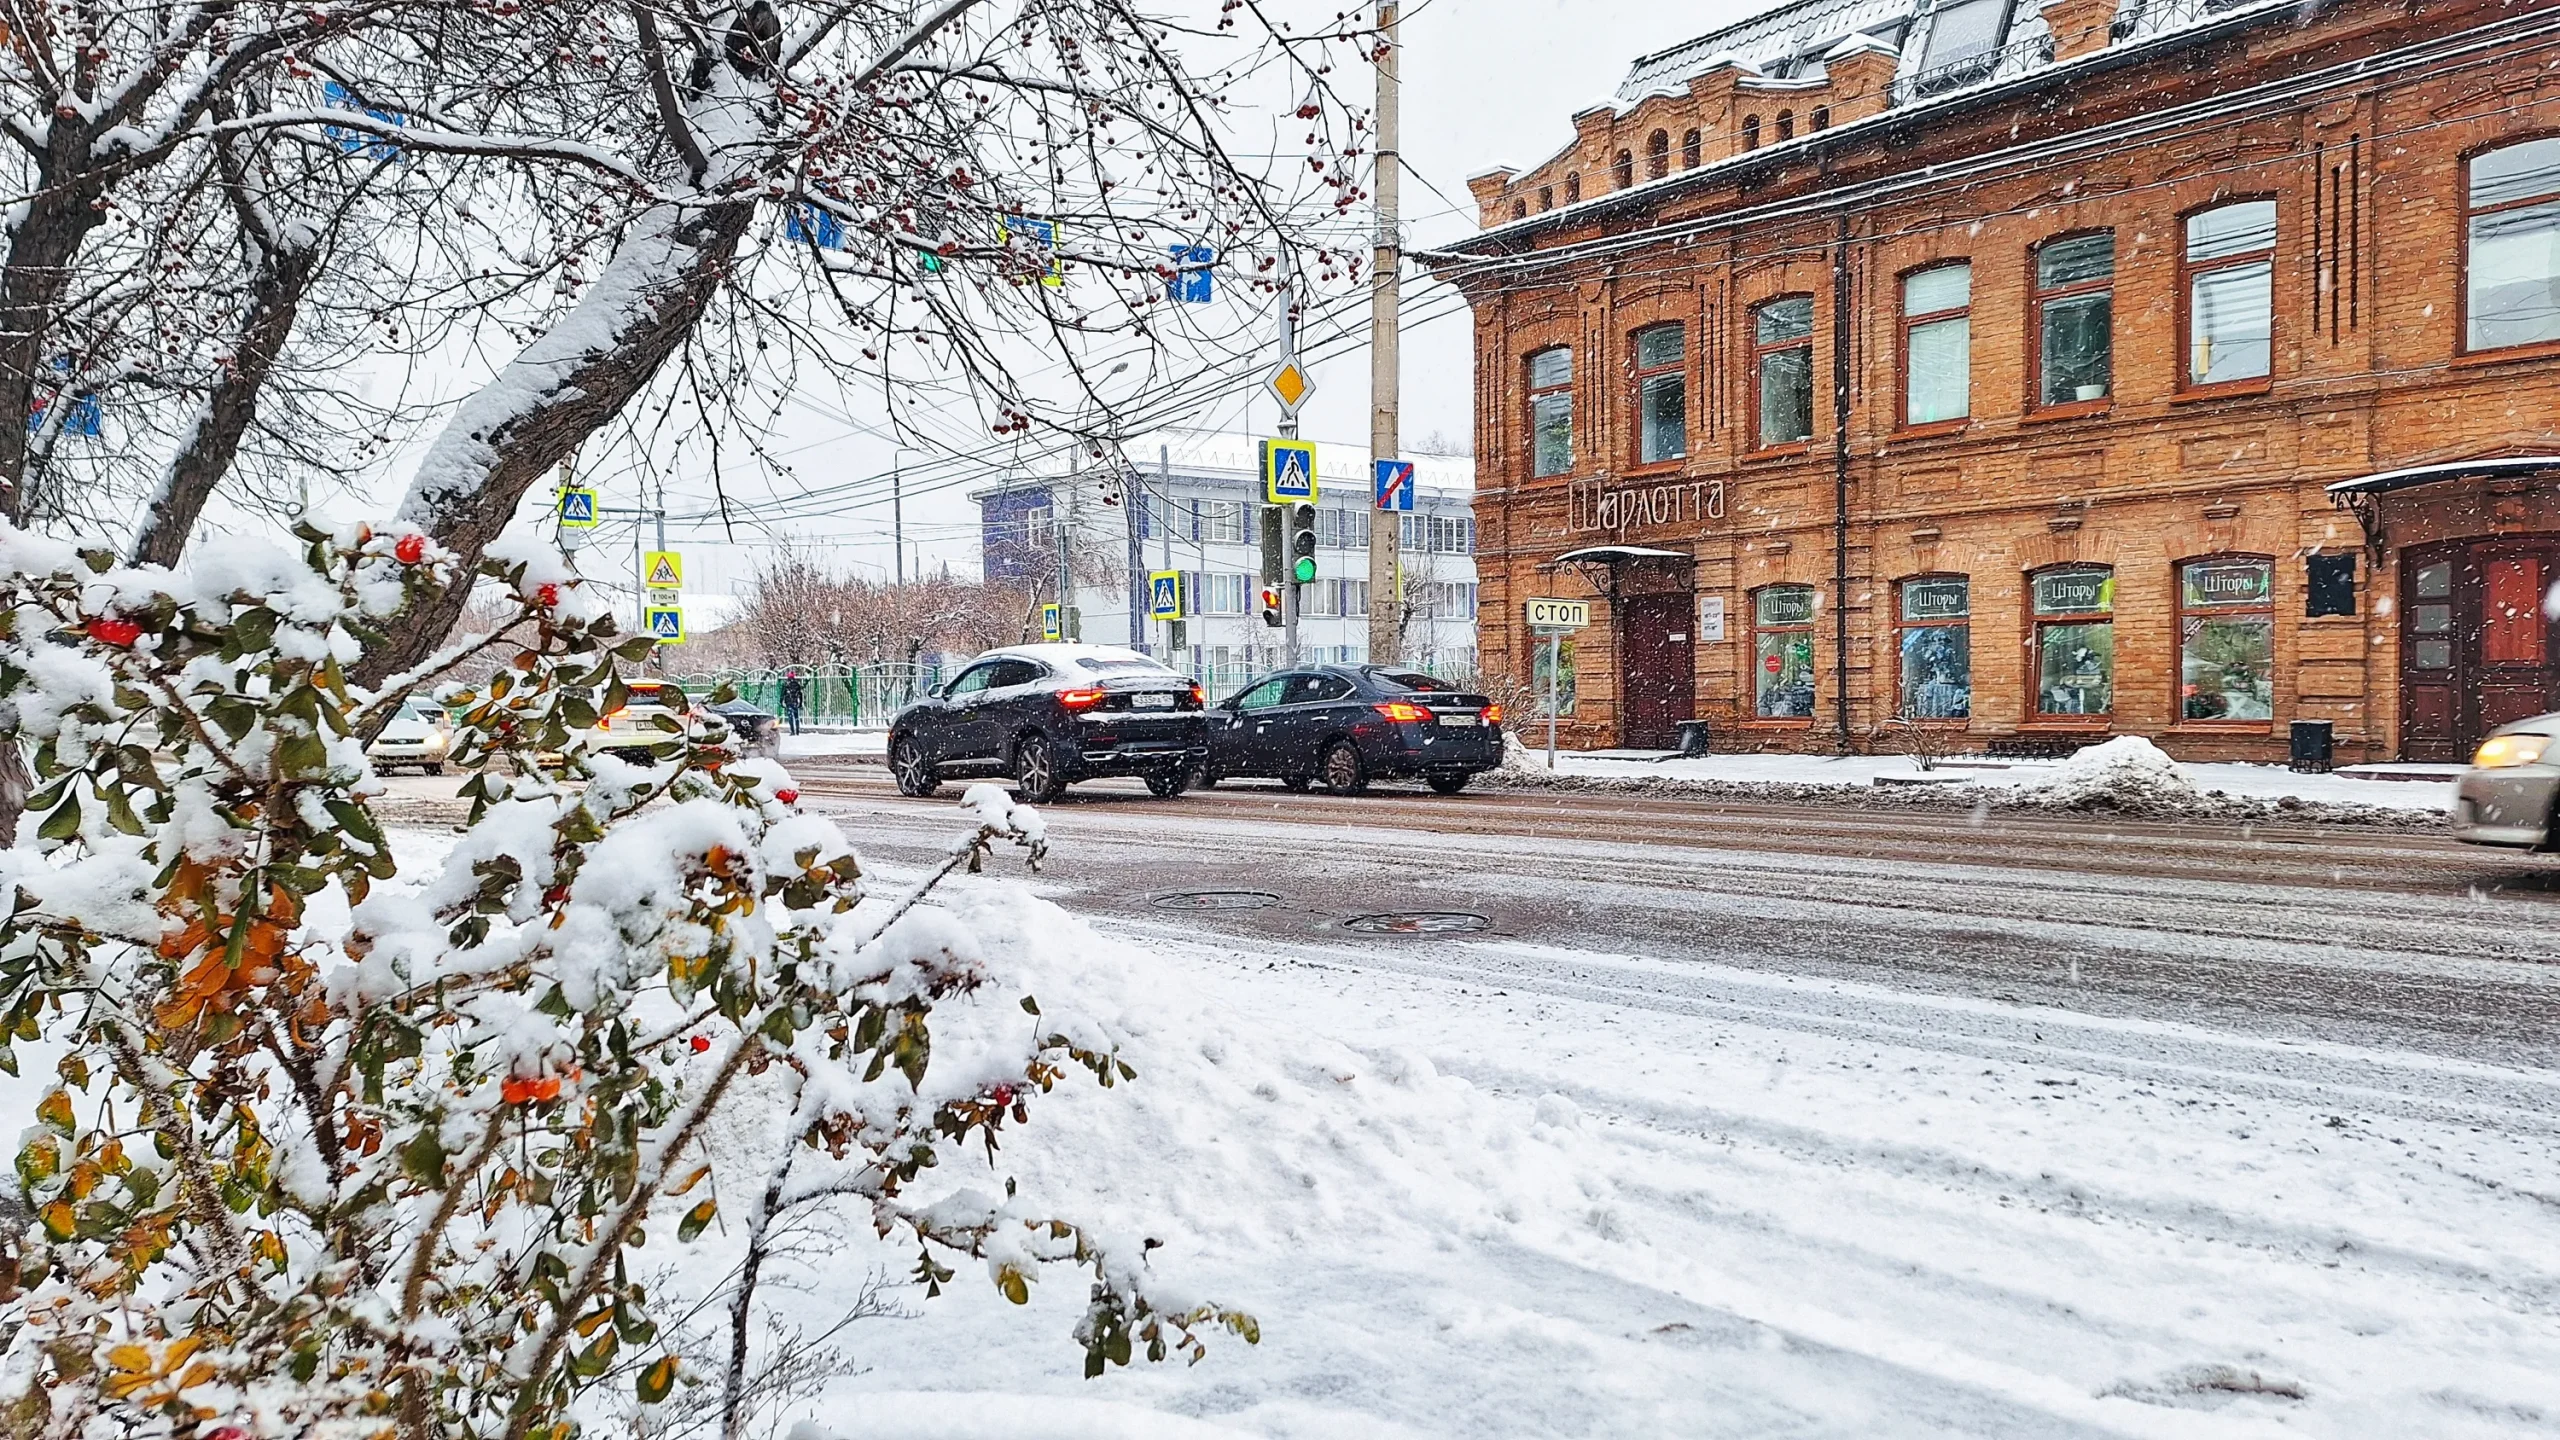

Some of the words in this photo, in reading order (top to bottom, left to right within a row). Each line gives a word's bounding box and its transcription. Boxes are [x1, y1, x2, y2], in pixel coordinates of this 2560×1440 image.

[1569, 480, 1724, 543] Шарлотта
[2052, 583, 2096, 601] Шторы
[2204, 575, 2253, 596] Шторы
[1771, 600, 1804, 617] Шторы
[1919, 592, 1959, 610] Шторы
[1535, 604, 1582, 622] СТОП
